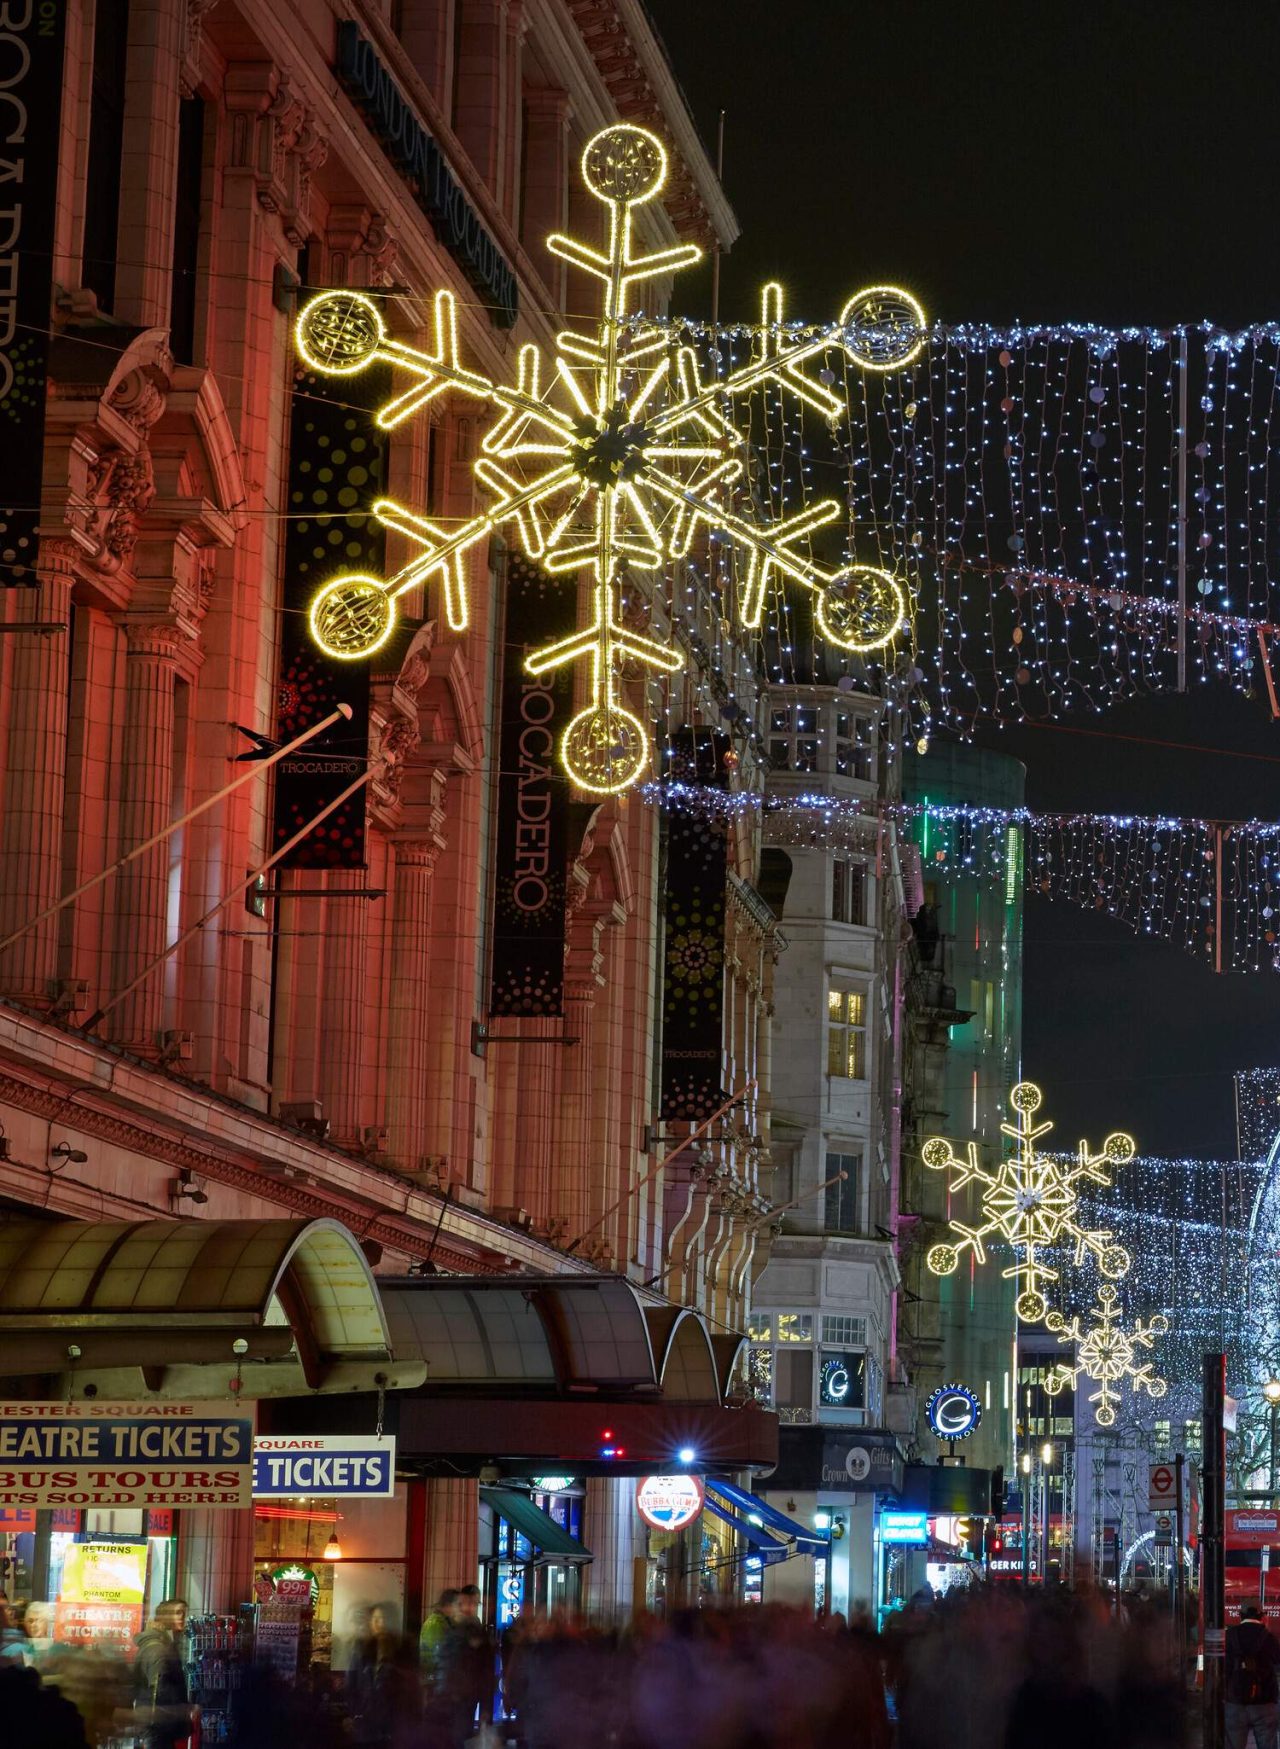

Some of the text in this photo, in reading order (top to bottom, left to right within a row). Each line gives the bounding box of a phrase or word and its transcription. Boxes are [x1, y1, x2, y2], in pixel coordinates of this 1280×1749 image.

[280, 762, 358, 774] TROCADERO
[925, 1383, 981, 1409] GROSVENOR
[0, 1405, 194, 1417] ESTER SQUARE
[930, 1425, 976, 1441] CASINOS
[0, 1425, 240, 1458] EATRE TICKETS
[870, 1447, 891, 1465] Gifts
[0, 1471, 77, 1488] BUS
[88, 1471, 241, 1488] TOURS
[268, 1456, 382, 1487] TICKETS
[821, 1463, 848, 1483] Crown
[0, 1492, 240, 1504] TS SOLD HERE
[641, 1493, 698, 1508] BUBBA GUMP
[52, 1508, 77, 1526] SALE
[148, 1513, 169, 1532] SALE
[82, 1545, 132, 1554] RETURNS
[83, 1590, 121, 1598] PHANTOM
[64, 1607, 133, 1622] THEATRE
[63, 1624, 131, 1639] TICKETS
